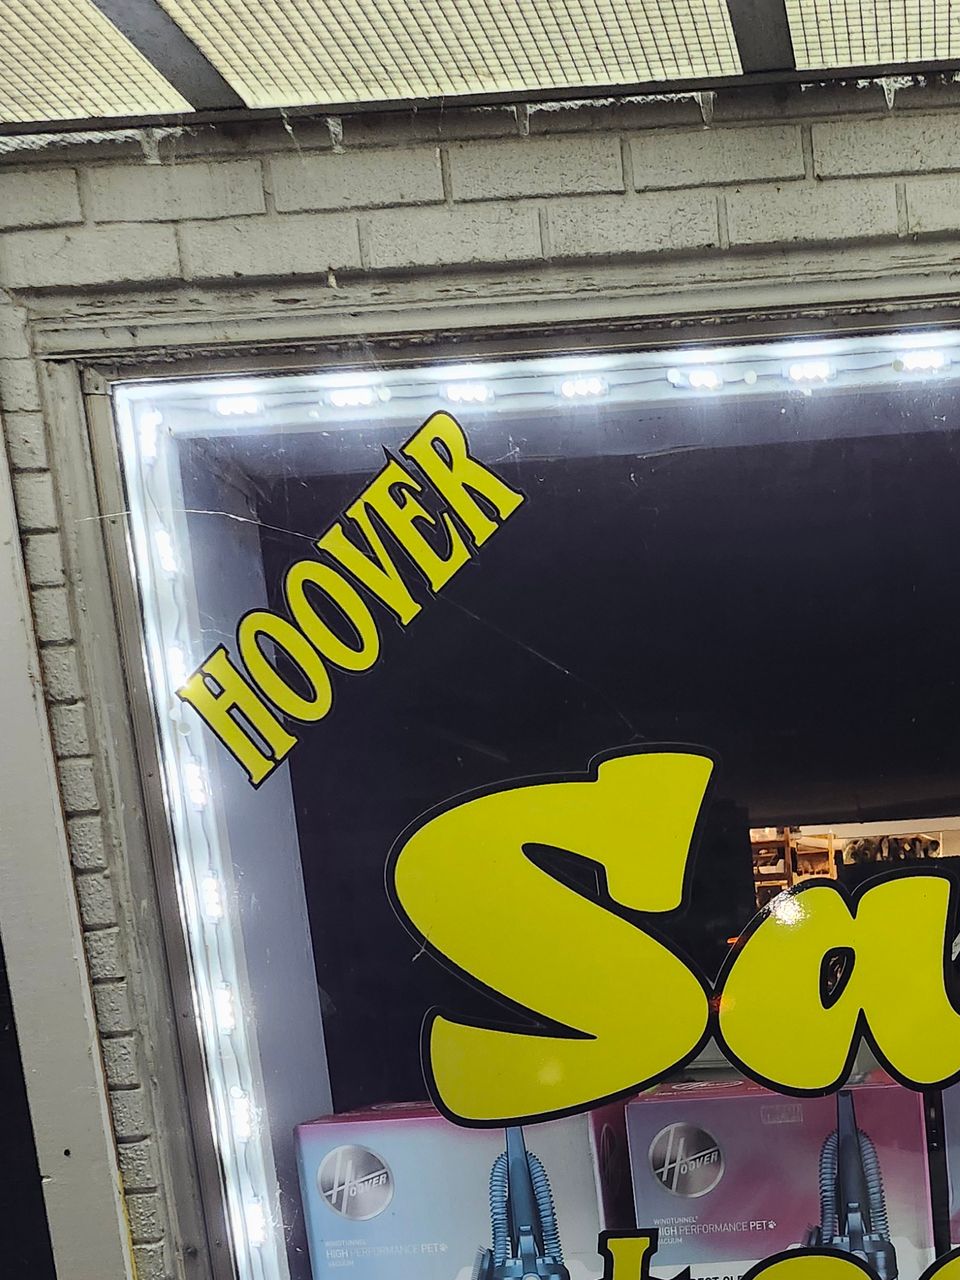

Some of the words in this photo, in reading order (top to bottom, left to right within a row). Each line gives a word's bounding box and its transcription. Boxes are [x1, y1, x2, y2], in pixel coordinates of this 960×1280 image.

[176, 410, 528, 790] HOOVER
[679, 1221, 748, 1235] PERFORMANCE
[749, 1220, 767, 1230] PET
[326, 1249, 349, 1258] HIGH
[421, 1243, 438, 1253] PET
